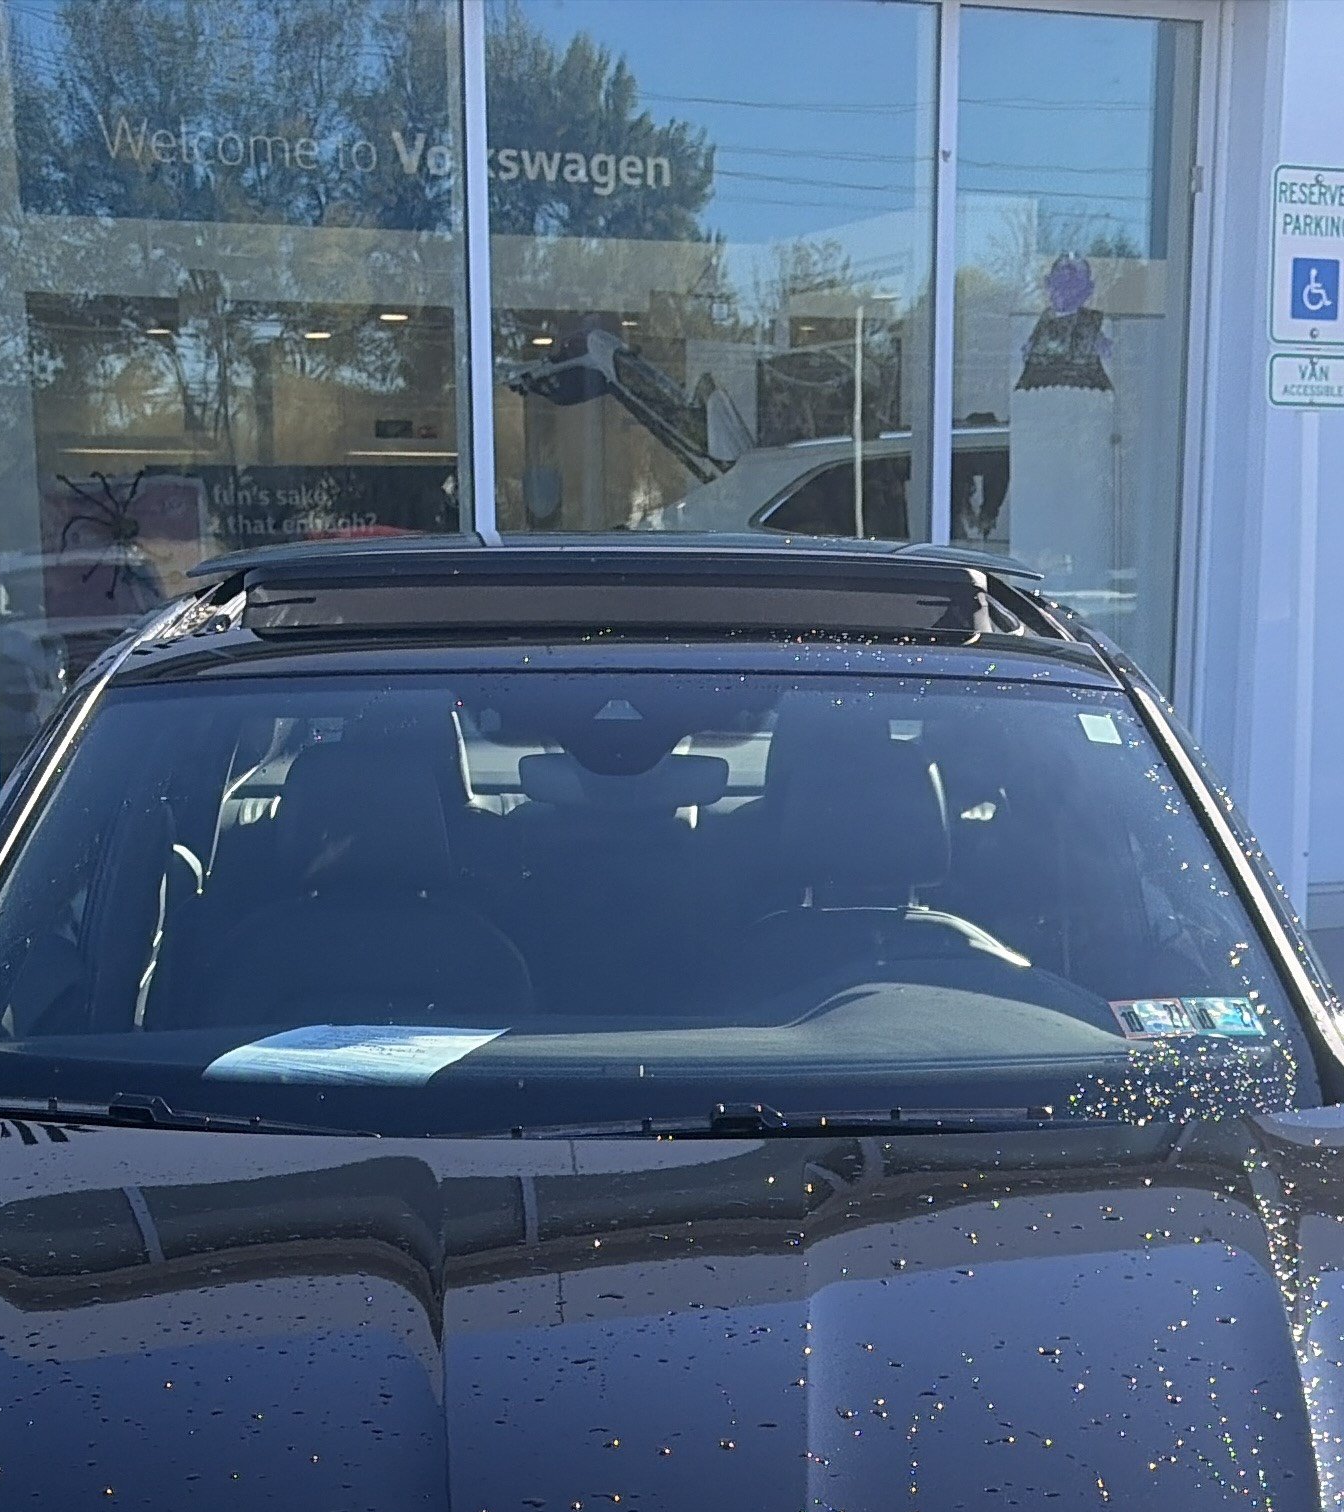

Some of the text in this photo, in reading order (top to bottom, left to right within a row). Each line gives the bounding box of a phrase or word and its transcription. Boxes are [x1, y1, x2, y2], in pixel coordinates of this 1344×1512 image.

[98, 113, 672, 196] Welcome to Voswagen
[1298, 364, 1329, 381] VAN
[213, 484, 270, 506] fun's
[227, 514, 276, 535] that
